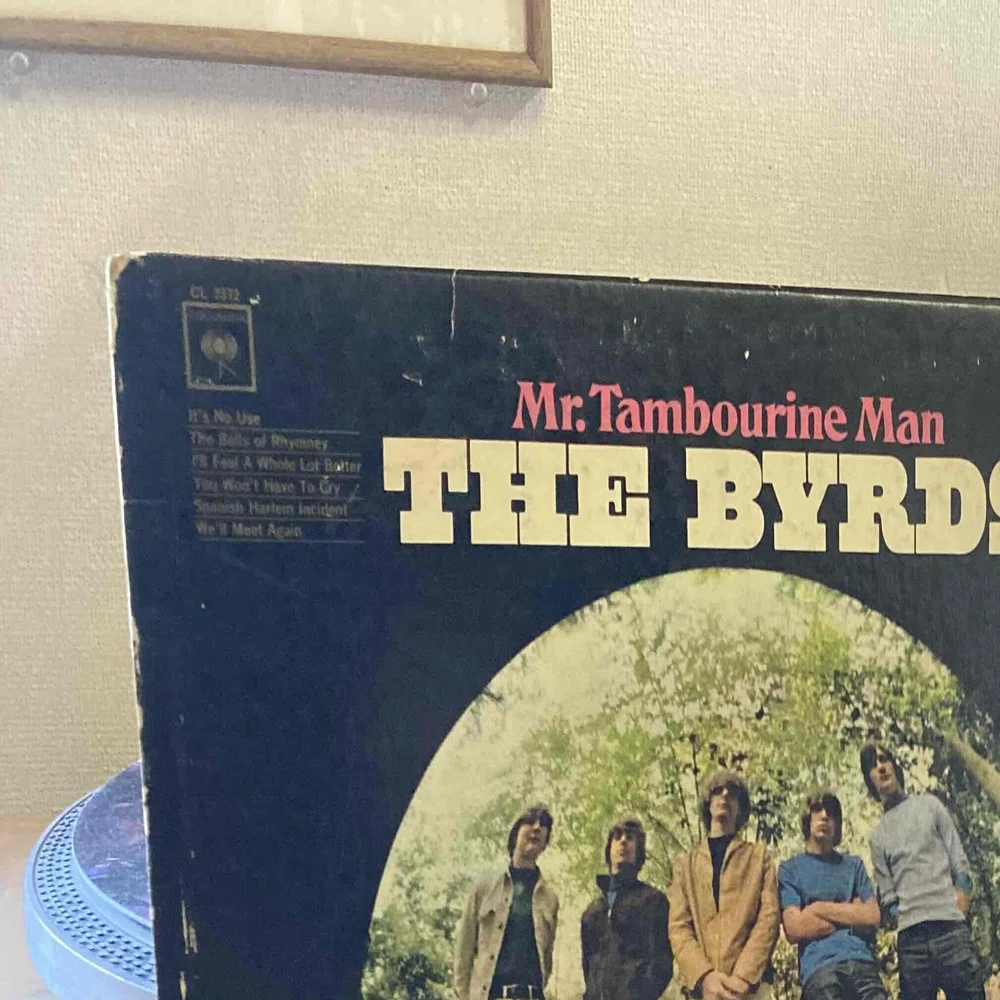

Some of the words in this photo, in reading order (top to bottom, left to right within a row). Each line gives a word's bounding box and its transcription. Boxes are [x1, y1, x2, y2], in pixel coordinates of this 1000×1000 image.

[189, 285, 207, 299] CL
[236, 410, 261, 426] Use
[512, 381, 586, 433] Mr.
[587, 383, 848, 442] Tambourine
[855, 396, 945, 445] Man
[382, 436, 650, 548] THE
